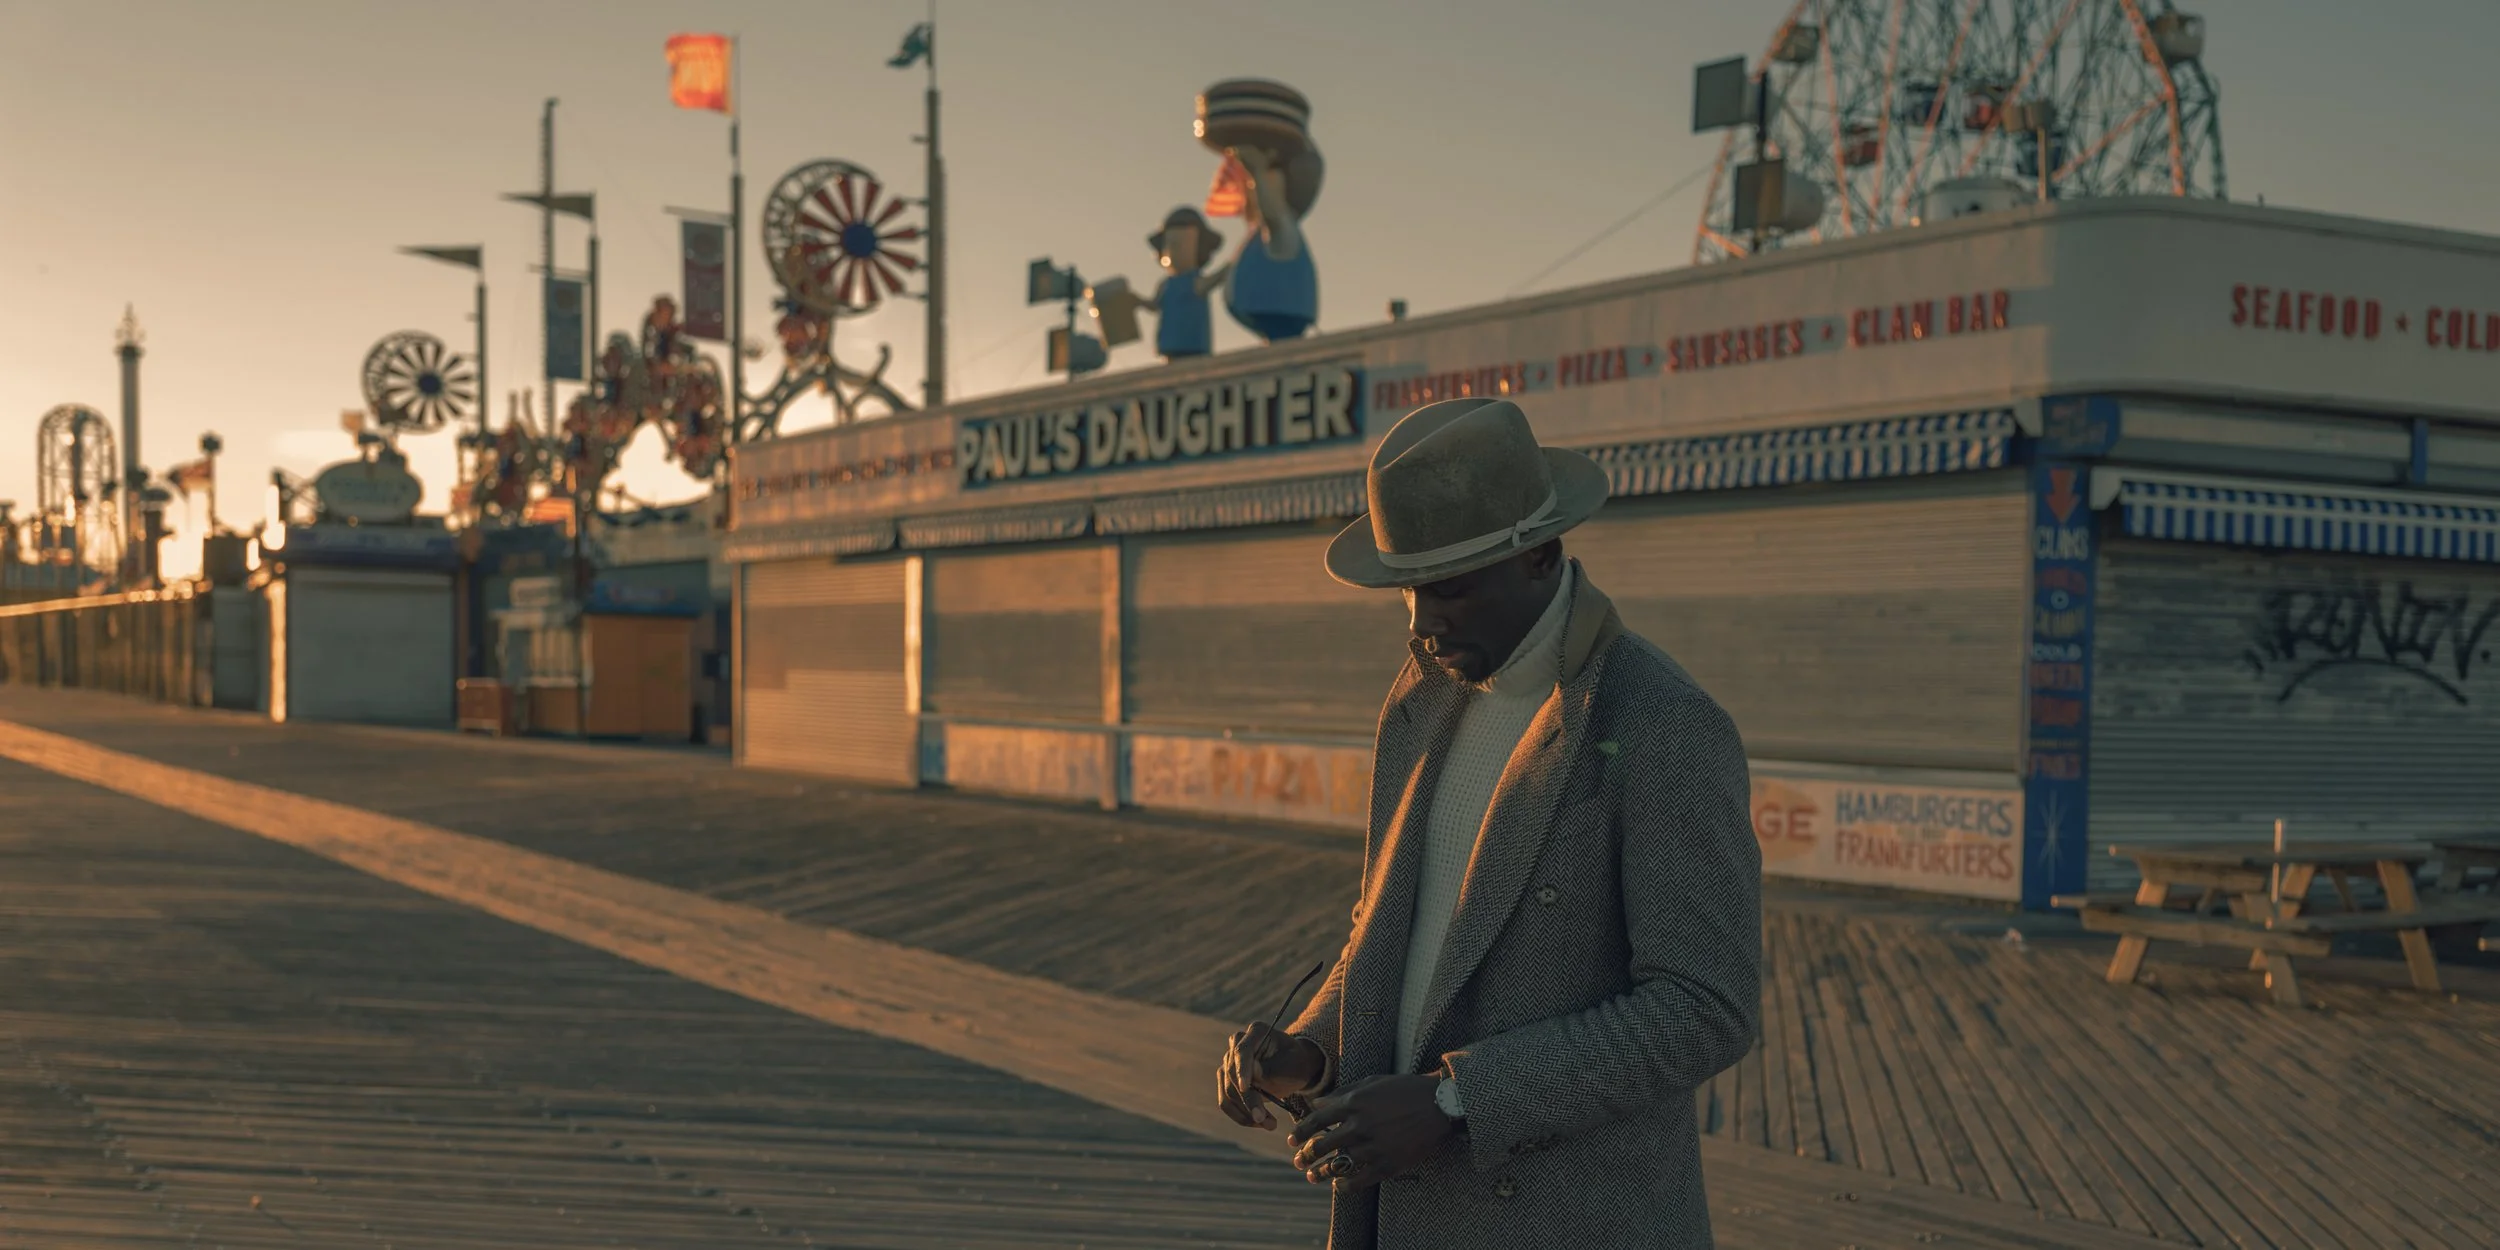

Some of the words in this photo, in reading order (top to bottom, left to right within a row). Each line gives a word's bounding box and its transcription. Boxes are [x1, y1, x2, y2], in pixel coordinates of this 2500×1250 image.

[1557, 346, 1630, 389] PIZZA
[1665, 319, 1806, 374] SAUSAGES
[1850, 300, 1934, 348] CLAM
[1946, 289, 2012, 335] BAR
[2231, 285, 2381, 338] SEAFOOD
[2427, 306, 2500, 352] COLD
[961, 411, 1082, 484] PAUL'S
[1088, 369, 1355, 468] DAUGHTER
[1835, 789, 2015, 837] HAMBURGERS
[1833, 830, 2016, 881] FRANKFURTERS
